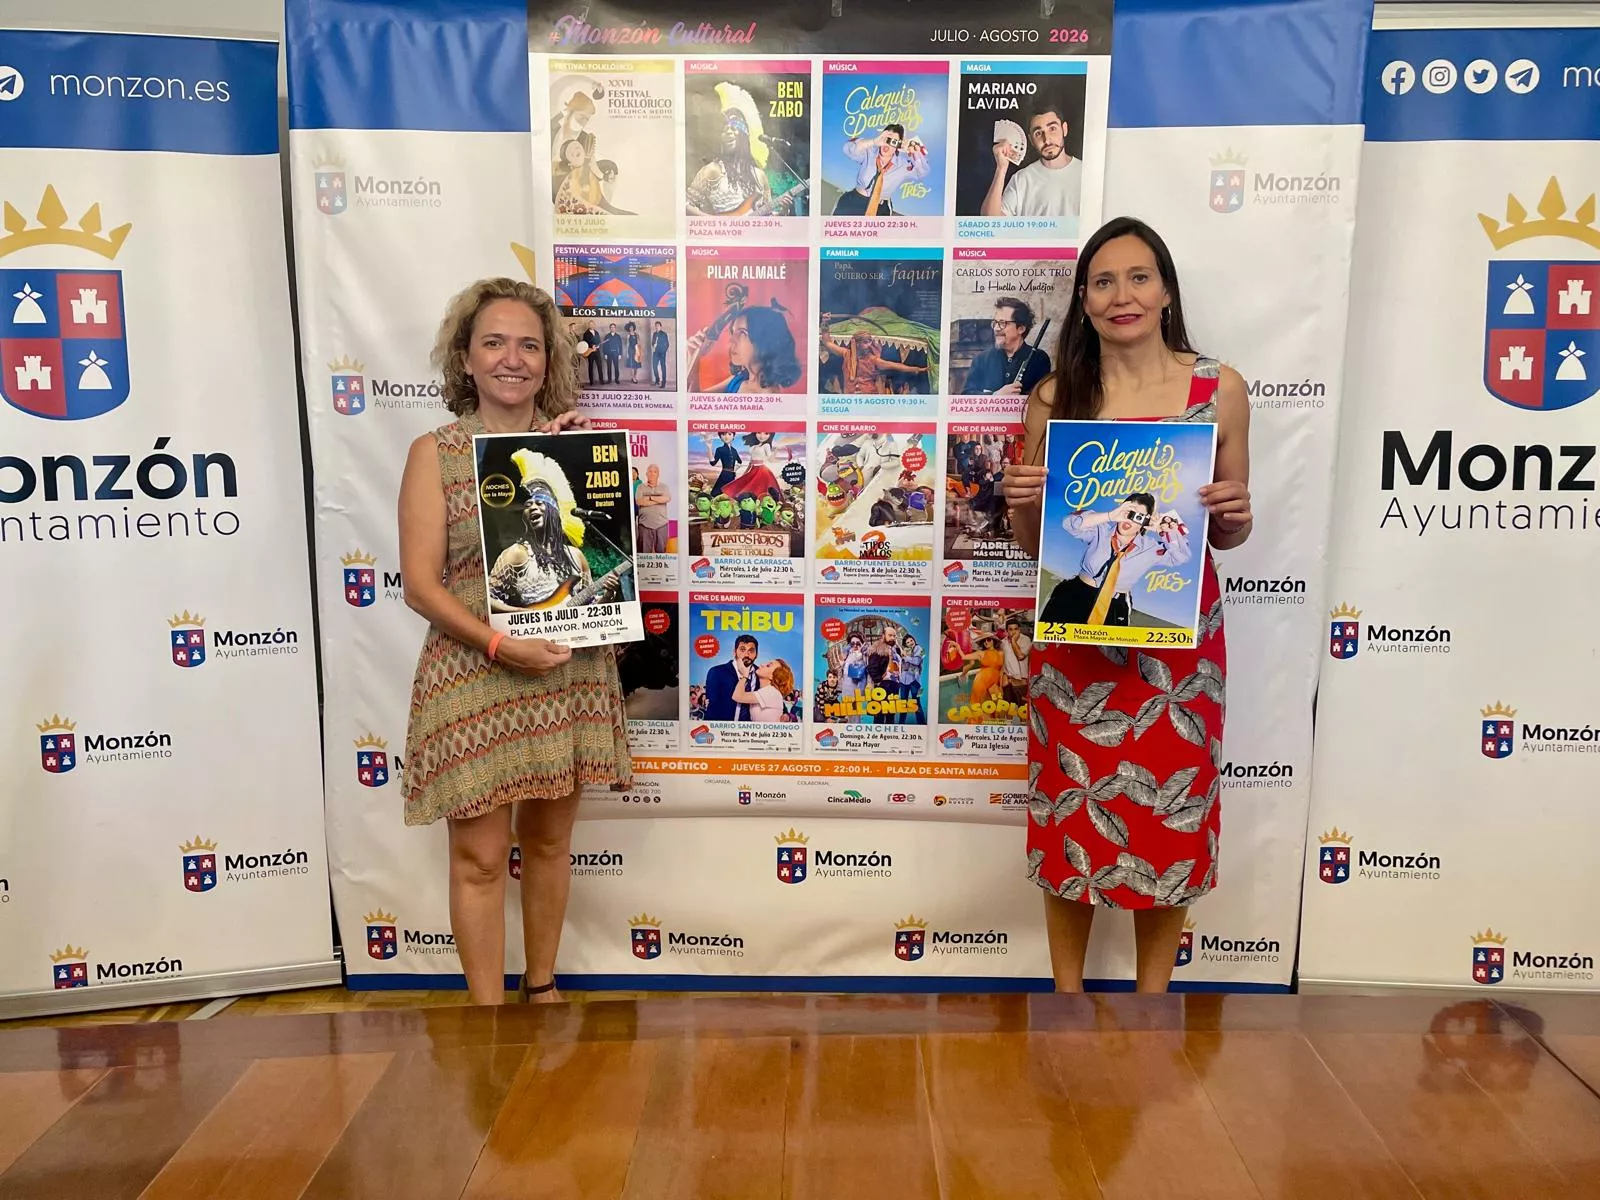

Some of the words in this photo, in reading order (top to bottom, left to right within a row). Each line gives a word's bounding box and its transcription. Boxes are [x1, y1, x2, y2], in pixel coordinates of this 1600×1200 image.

[668, 22, 756, 45] Cultural
[930, 30, 969, 42] JULIO
[980, 30, 1039, 42] AGOSTO
[1050, 29, 1089, 42] 2026
[828, 63, 858, 72] MÚSICA
[966, 64, 992, 72] MAGIA
[50, 74, 230, 102] monzon.es
[777, 81, 803, 98] BEN
[968, 82, 1038, 95] MARIANO
[769, 100, 803, 118] ZABO
[968, 98, 1019, 110] LAVIDA
[354, 176, 441, 195] Monzón
[1254, 172, 1341, 191] Monzón
[356, 197, 442, 208] Ayuntamiento
[1253, 193, 1339, 205] Ayuntamiento
[715, 229, 742, 237] MAYOR
[824, 230, 848, 238] PLAZA
[850, 230, 878, 238] MAYOR
[958, 230, 994, 238] CONCHEL
[555, 246, 589, 255] FESTIVAL
[590, 247, 622, 255] CAMINO
[635, 247, 674, 256] SANTIAGO
[691, 248, 719, 256] MÚSICA
[959, 249, 986, 257] MÚSICA
[707, 265, 738, 280] PILAR
[741, 263, 786, 281] ALMALÉ
[956, 268, 992, 277] CARLOS
[995, 269, 1020, 277] SOTO
[1022, 269, 1046, 277] FOLK
[1050, 267, 1072, 277] TRÍO
[740, 403, 764, 411] MARÍA
[592, 445, 618, 464] BEN
[1381, 430, 1597, 491] Monz
[0, 437, 238, 503] onzón
[585, 471, 620, 489] ZABO
[1, 507, 240, 542] ntamiento
[710, 534, 752, 547] ZAPATOS
[753, 534, 784, 547] ROJOS
[863, 541, 890, 550] TIPOS
[859, 550, 892, 558] MALOS
[1145, 569, 1191, 593] TRES
[1225, 576, 1306, 593] Monzón
[1224, 594, 1305, 606] Ayuntamiento
[508, 612, 540, 625] JUEVES
[543, 611, 552, 622] 16
[555, 609, 578, 621] JULIO
[587, 606, 612, 618] 22:30
[615, 605, 621, 614] H
[701, 610, 794, 632] TRIBU
[510, 628, 541, 636] PLAZA
[582, 619, 623, 629] MONZÓN
[1044, 622, 1067, 634] 23
[1074, 628, 1108, 636] Monzón
[1367, 625, 1451, 642] Monzón
[214, 628, 297, 647] Monzón
[1146, 632, 1193, 643] 22:30h
[215, 645, 299, 659] Ayuntamiento
[1367, 642, 1451, 654] Ayuntamiento
[824, 699, 919, 717] MILLONES
[975, 726, 1024, 734] SELGUA
[84, 731, 171, 752] Monzón
[863, 741, 880, 749] Mayor
[86, 749, 172, 764] Ayuntamiento
[632, 762, 659, 770] CITAL
[661, 761, 709, 771] POÉTICO
[731, 763, 765, 772] JUEVES
[767, 764, 779, 772] 27
[782, 764, 821, 773] AGOSTO
[834, 765, 861, 773] 22:00
[887, 767, 917, 775] PLAZA
[919, 767, 932, 775] DE
[934, 767, 964, 775] SANTA
[967, 766, 999, 776] MARÍA
[755, 791, 786, 799] Monzón
[827, 795, 871, 804] CincaMedio
[225, 849, 308, 871] Monzón
[815, 850, 891, 867] Monzón
[1359, 851, 1441, 869] Monzón
[226, 866, 309, 882] Ayuntamiento
[815, 868, 891, 879] Ayuntamiento
[1359, 868, 1441, 881] Ayuntamiento
[668, 932, 744, 948] Monzón
[932, 930, 1008, 945] Monzón
[1201, 935, 1280, 952] Monzón
[669, 946, 744, 958] Ayuntamiento
[932, 945, 1008, 956] Ayuntamiento
[1201, 952, 1280, 964] Ayuntamiento
[1513, 952, 1593, 969] Monzón
[96, 957, 182, 979] Monzón
[1513, 968, 1594, 981] Ayuntamiento
